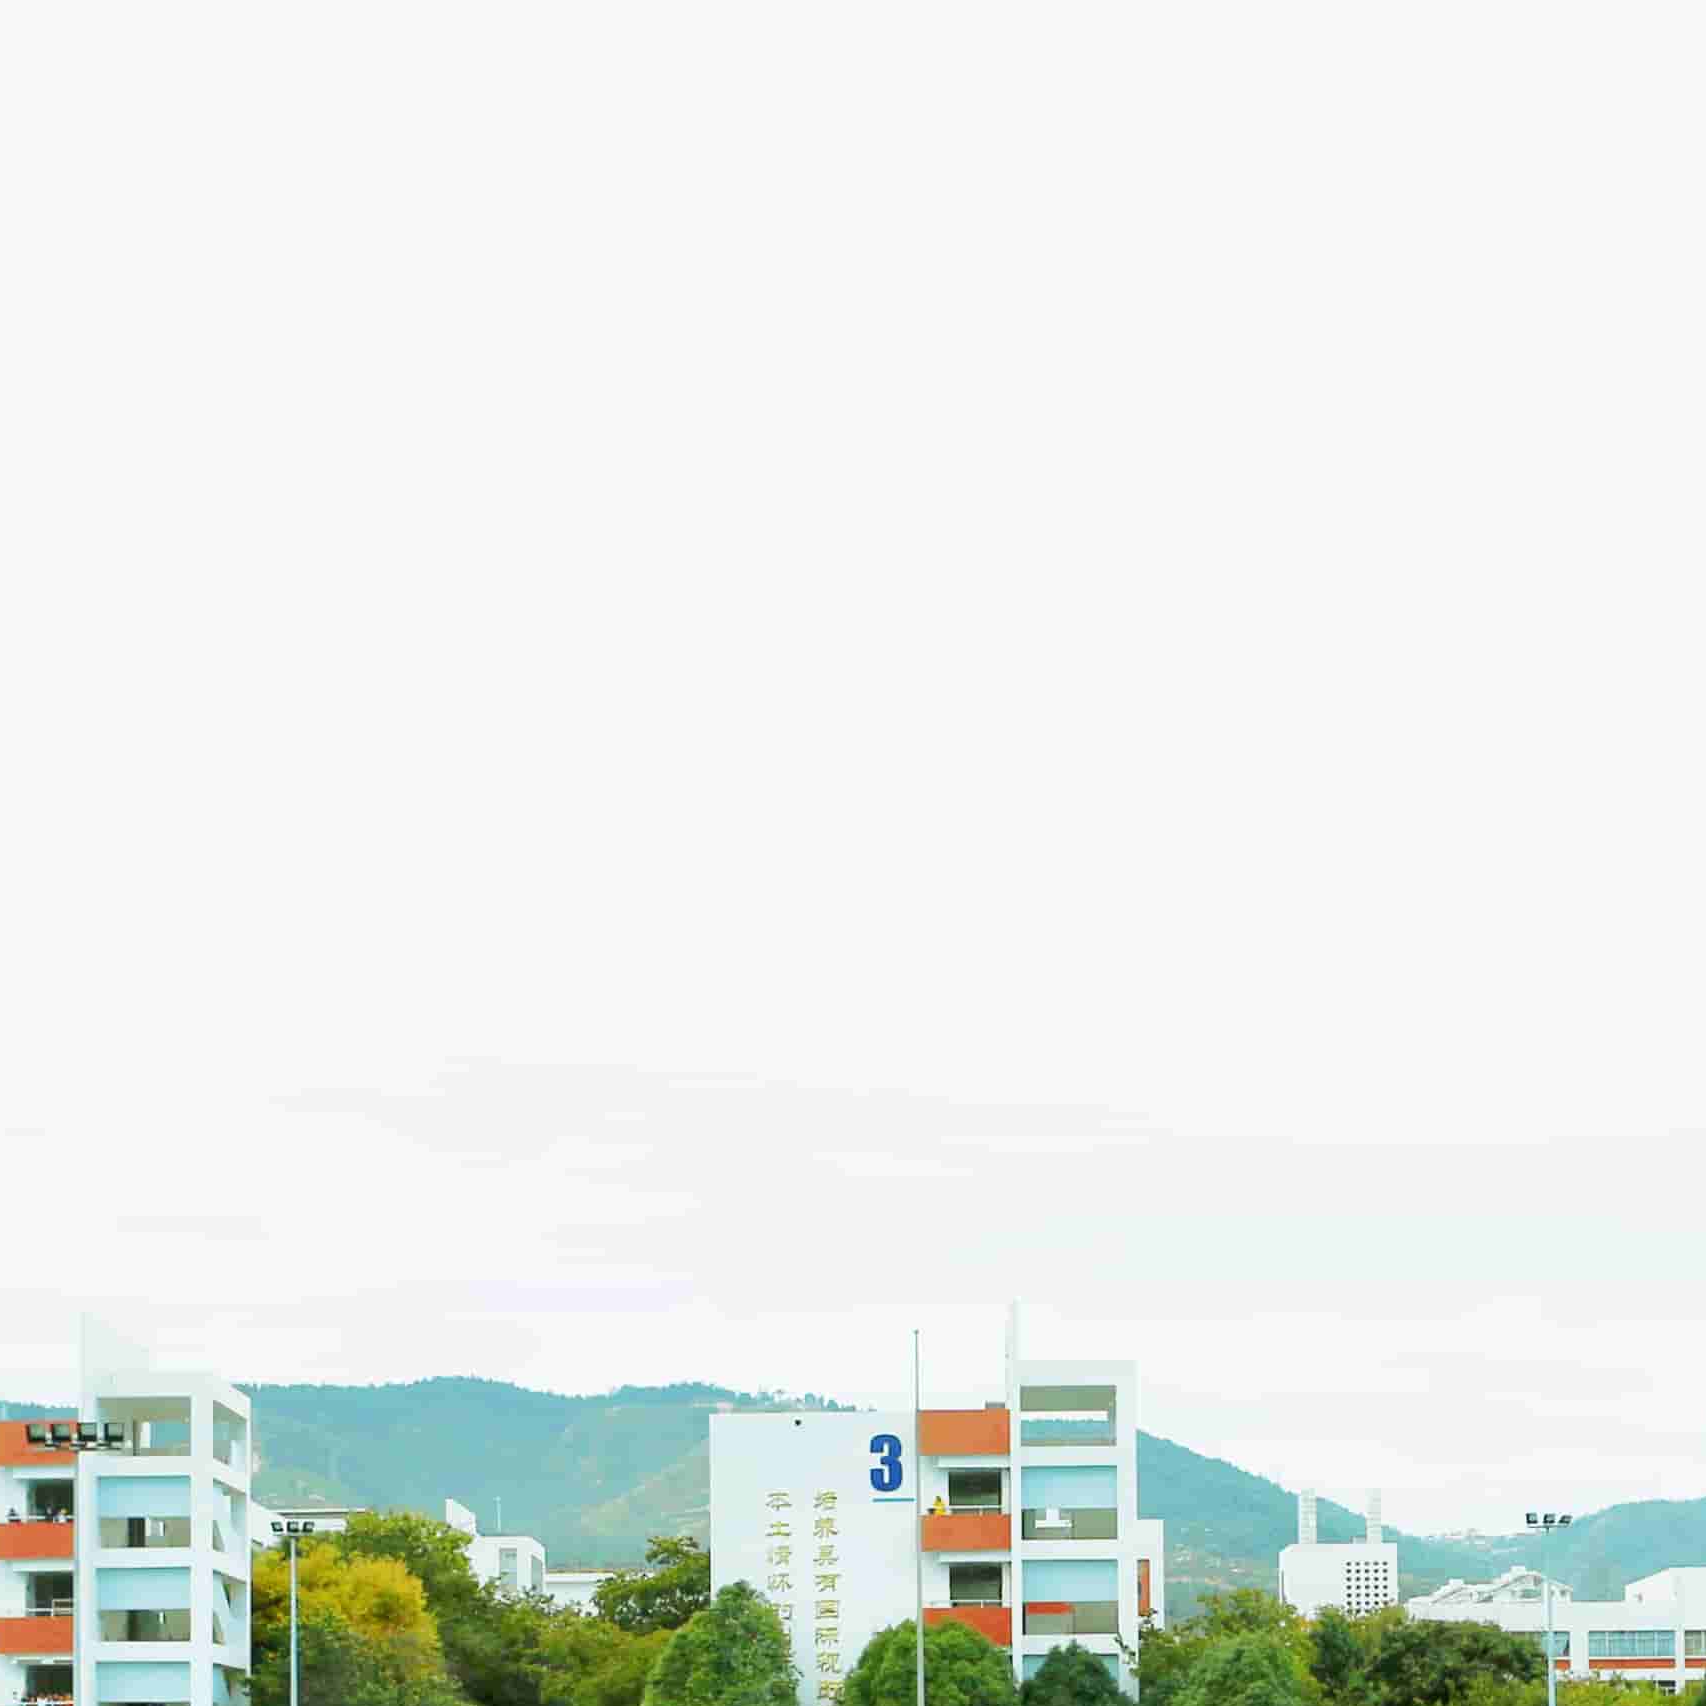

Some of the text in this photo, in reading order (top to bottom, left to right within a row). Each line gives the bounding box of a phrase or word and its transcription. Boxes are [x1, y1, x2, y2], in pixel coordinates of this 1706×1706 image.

[870, 1434, 902, 1492] 3
[765, 1492, 793, 1665] 本土情怀的
